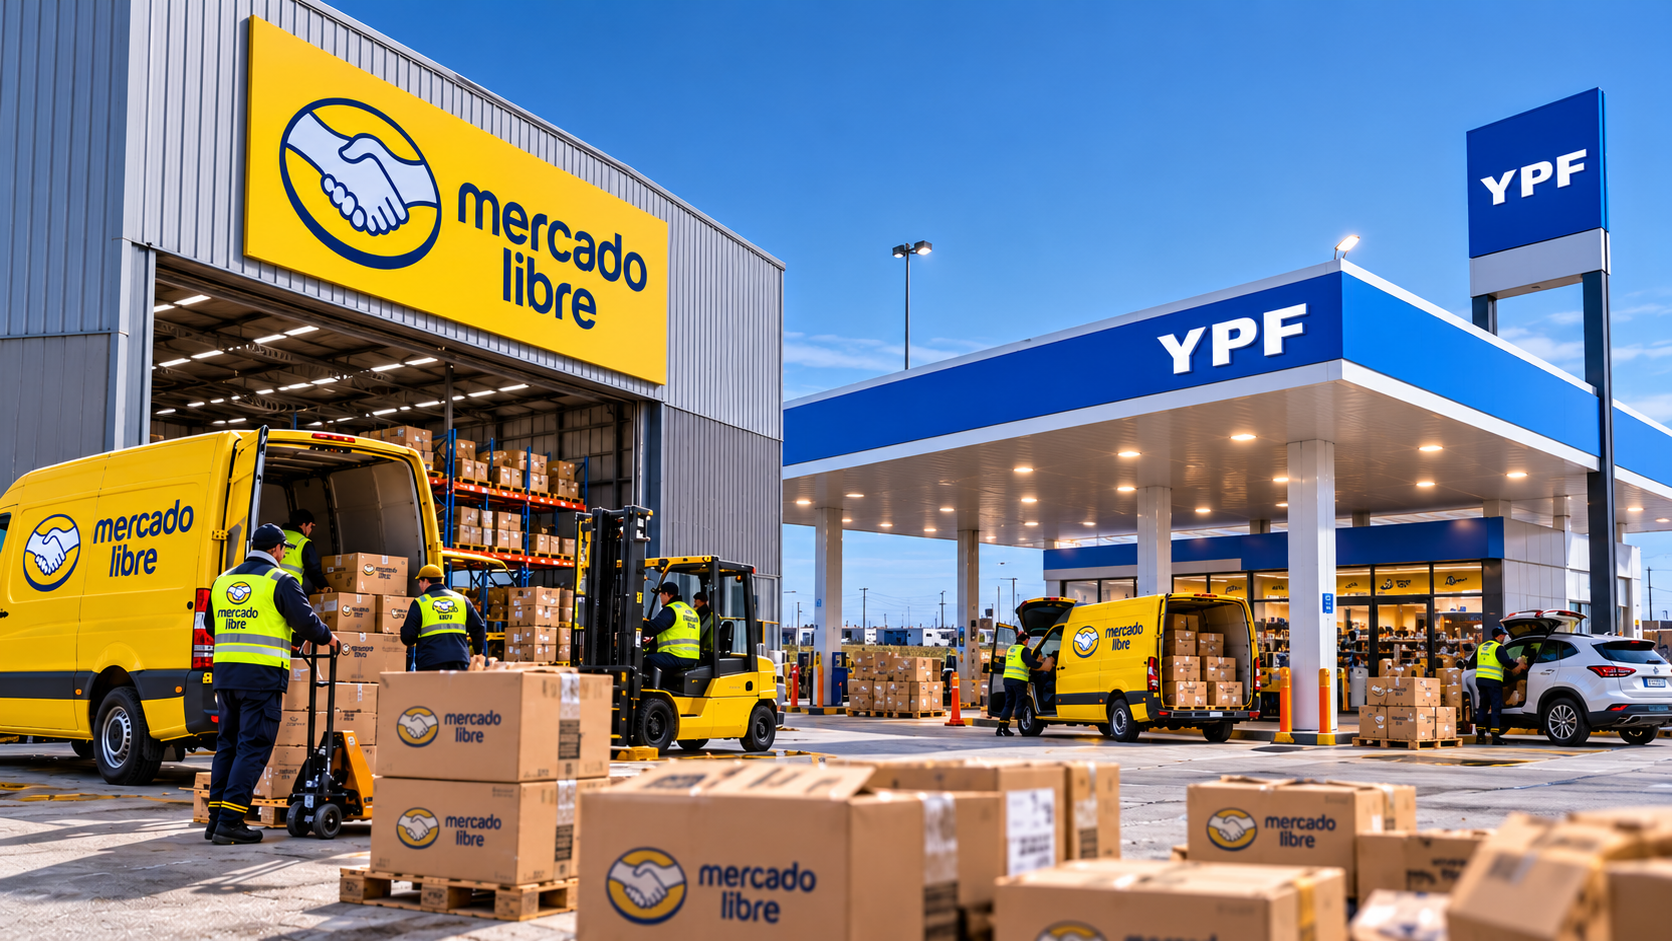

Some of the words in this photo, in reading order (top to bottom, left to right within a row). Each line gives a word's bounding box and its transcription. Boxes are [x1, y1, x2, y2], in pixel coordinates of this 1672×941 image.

[1480, 148, 1587, 206] YPF
[457, 182, 648, 293] mercado
[502, 247, 597, 330] libre
[1157, 303, 1307, 375] YPF
[93, 499, 194, 541] mercado
[109, 544, 158, 578] libre
[217, 606, 259, 619] mercado
[225, 618, 247, 630] libre
[1104, 621, 1144, 639] mercado
[444, 709, 502, 726] mercado
[455, 726, 485, 744] libre
[445, 813, 502, 830] mercado
[1264, 813, 1337, 832] mercado
[455, 829, 485, 847] libre
[1279, 829, 1316, 849] libre
[698, 861, 817, 893] mercado
[721, 888, 781, 924] libre
